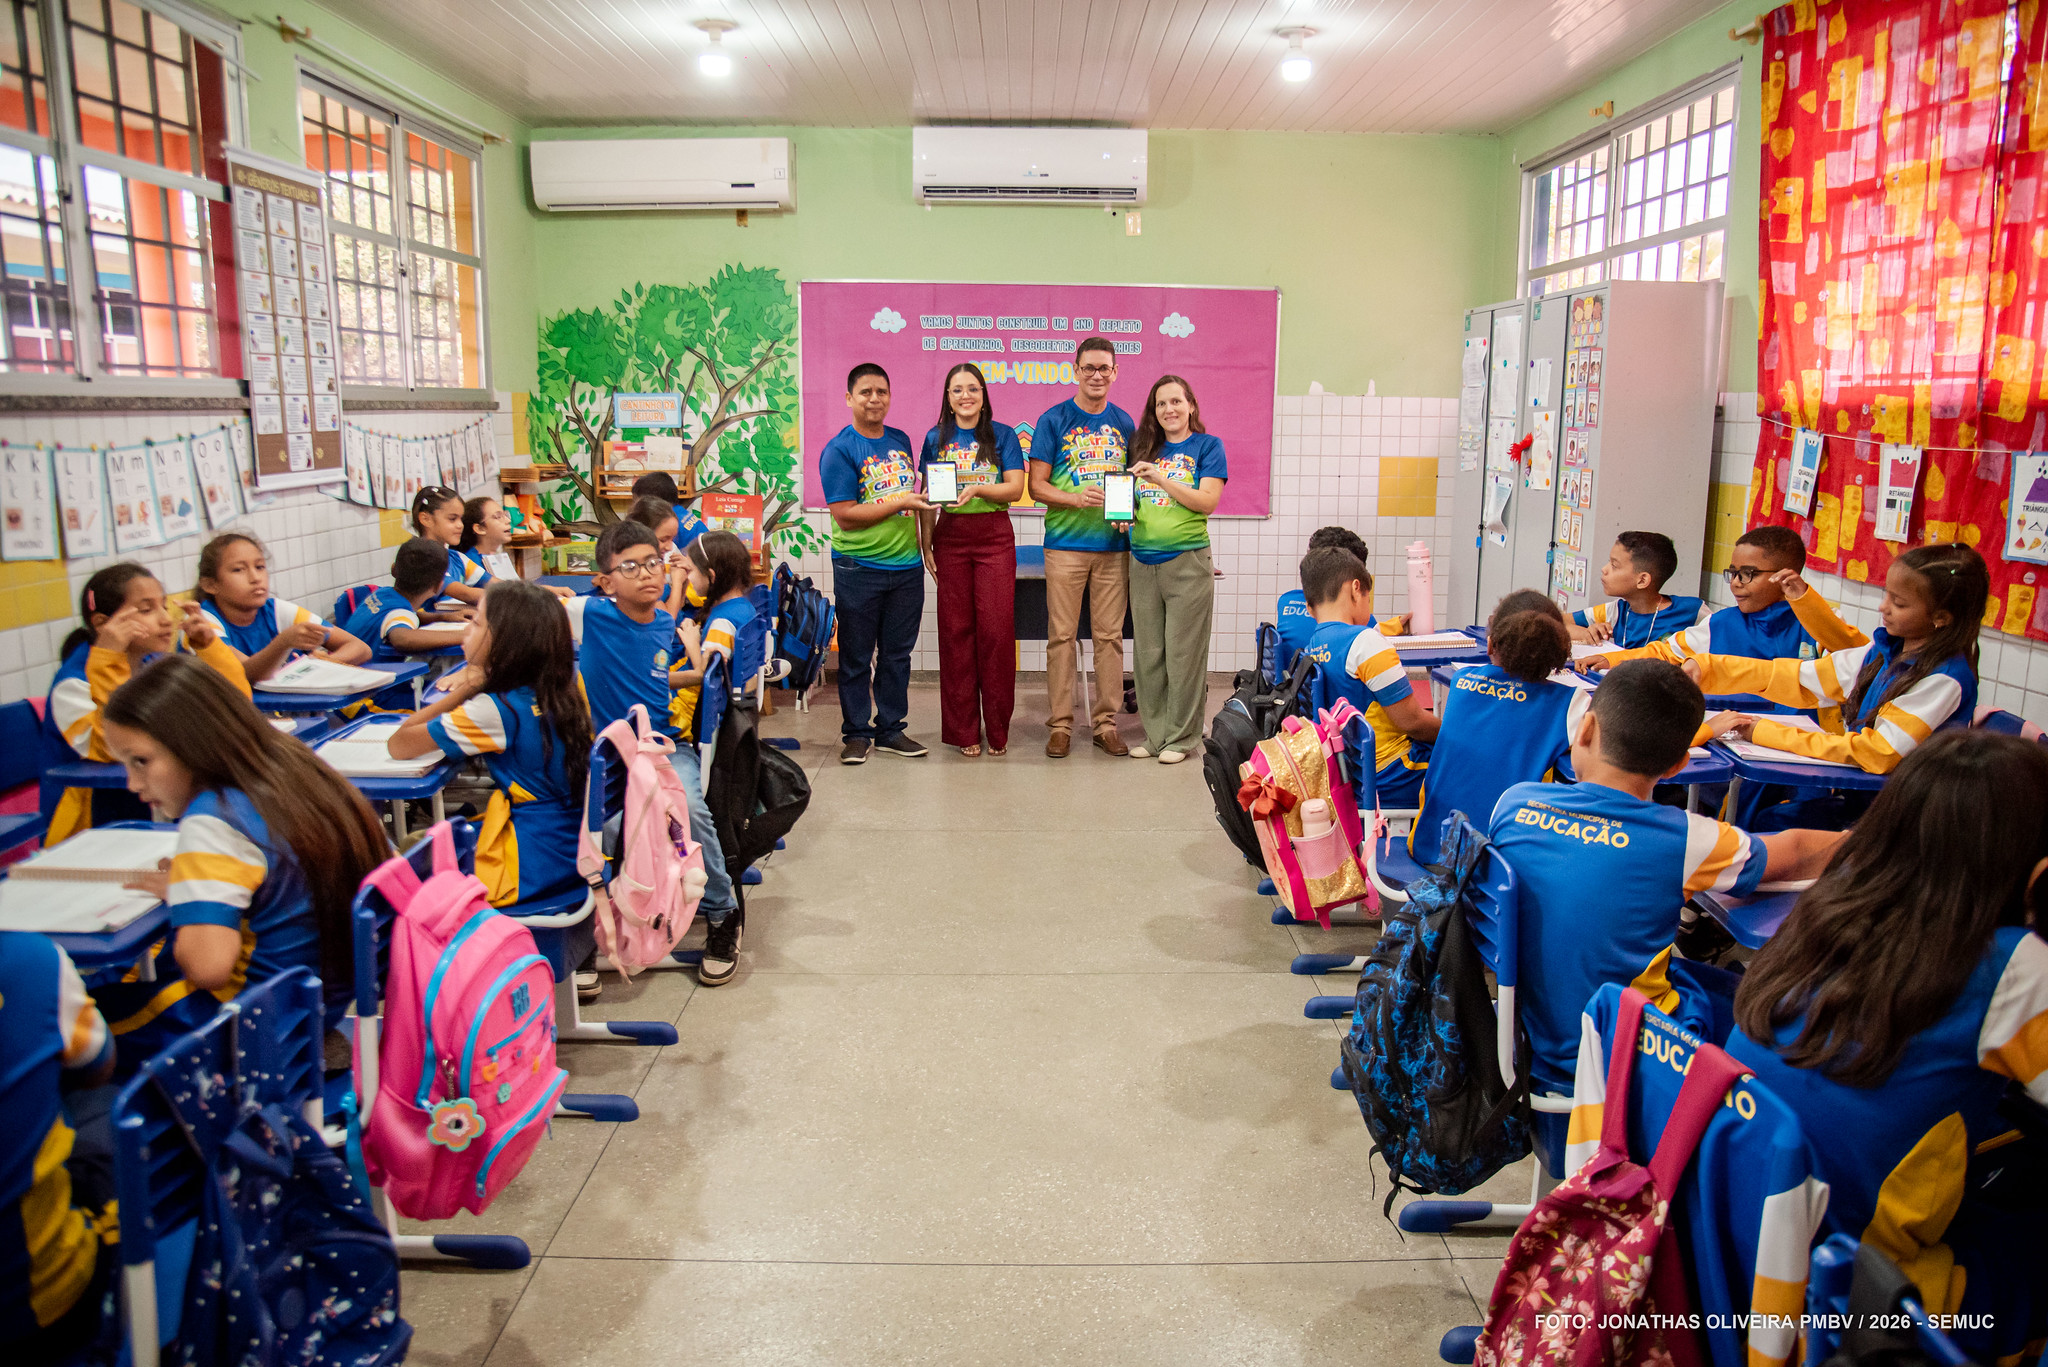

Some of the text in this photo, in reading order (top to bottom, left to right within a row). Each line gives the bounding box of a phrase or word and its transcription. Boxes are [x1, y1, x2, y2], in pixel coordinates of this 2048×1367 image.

[921, 315, 1142, 333] VAMOS JUNTOS CONSTRUIR UM ANO REPLETO
[922, 337, 1142, 354] DE APRENDIZADO, DESCOBERTAS ZADES
[970, 361, 1080, 385] EM-VINDO
[620, 400, 677, 411] CANTINHO DA
[631, 411, 666, 422] LEITURA
[1076, 434, 1116, 447] letras
[946, 450, 977, 460] letra
[869, 460, 908, 479] letras
[1283, 606, 1311, 617] EDUC
[1456, 678, 1527, 702] EDUCAÇÃO
[1514, 808, 1630, 848] EDUCAÇÃO
